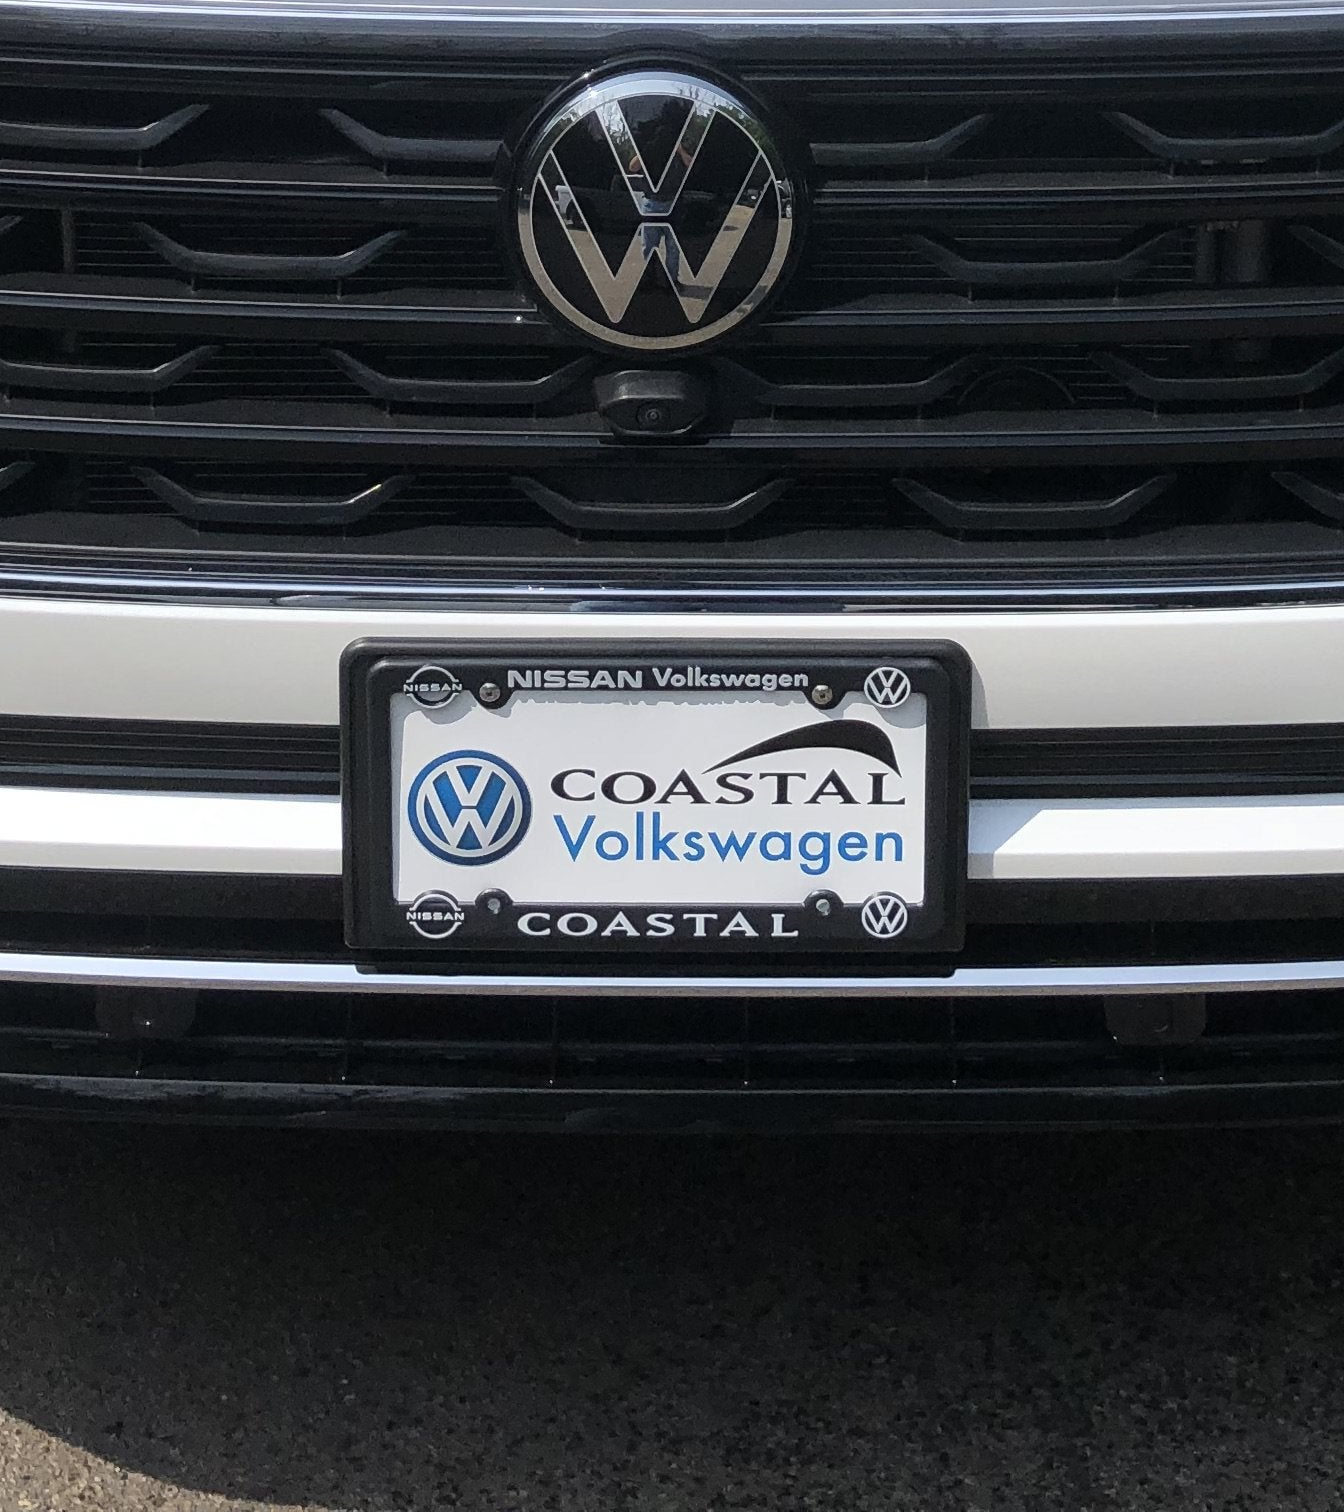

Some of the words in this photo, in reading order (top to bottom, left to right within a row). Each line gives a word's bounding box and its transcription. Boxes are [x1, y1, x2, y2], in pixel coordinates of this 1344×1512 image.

[403, 683, 463, 692] NISSAN
[507, 669, 643, 689] NISSAN
[653, 666, 809, 691] Volkswagen
[549, 768, 907, 805] COASTAL
[553, 811, 903, 875] Volkswagen
[406, 912, 465, 921] NISSAN
[517, 911, 800, 937] COASTAL
